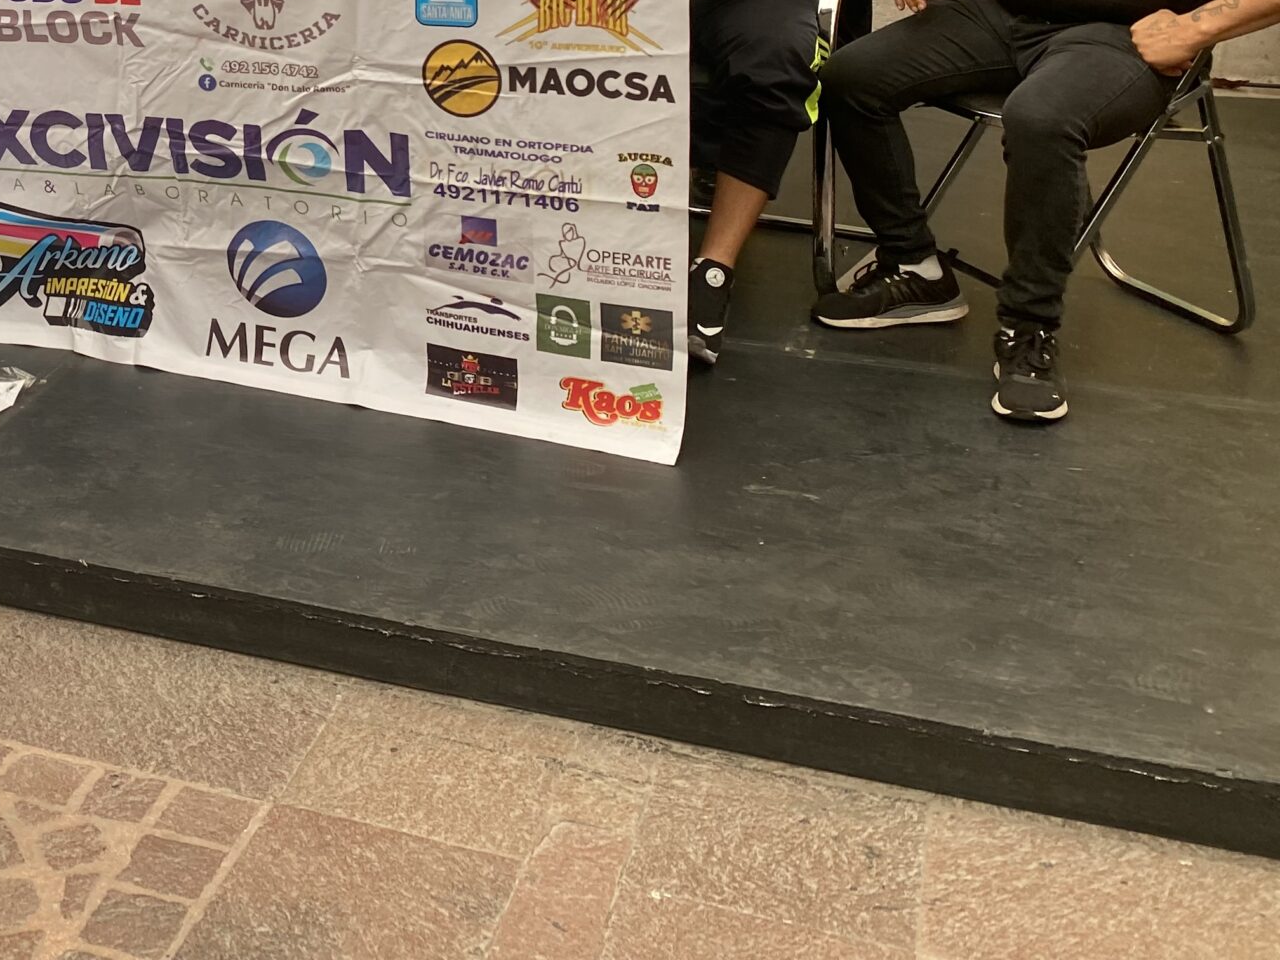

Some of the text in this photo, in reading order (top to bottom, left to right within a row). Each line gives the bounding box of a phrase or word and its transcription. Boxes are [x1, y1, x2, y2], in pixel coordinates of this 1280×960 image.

[192, 3, 341, 50] CARNICERIA
[221, 60, 320, 79] 492 156 4742
[508, 66, 677, 104] MAOCSA
[424, 130, 594, 154] CIRUJANO EN ORTOPEDIA
[452, 145, 563, 164] TRAUMATOLOGO
[616, 152, 674, 168] LUCHA
[474, 167, 507, 187] Javier
[509, 171, 545, 191] Romo
[43, 179, 57, 194] &
[74, 182, 408, 227] LABORATORIO
[432, 183, 580, 213] 4921171406
[428, 243, 530, 272] CEMOZAC
[586, 248, 673, 272] OPERARTE
[448, 261, 511, 279] S.A. DE C.V.
[586, 264, 611, 276] ARTE
[612, 266, 628, 277] EN
[628, 268, 673, 282] CIRUGÍA
[128, 284, 148, 306] &
[425, 308, 478, 324] TRANSPORTES
[426, 315, 531, 342] CHIHUAHUENSES
[206, 317, 351, 380] MEGA
[604, 332, 670, 352] FARMACIA
[559, 375, 664, 427] Kaos
